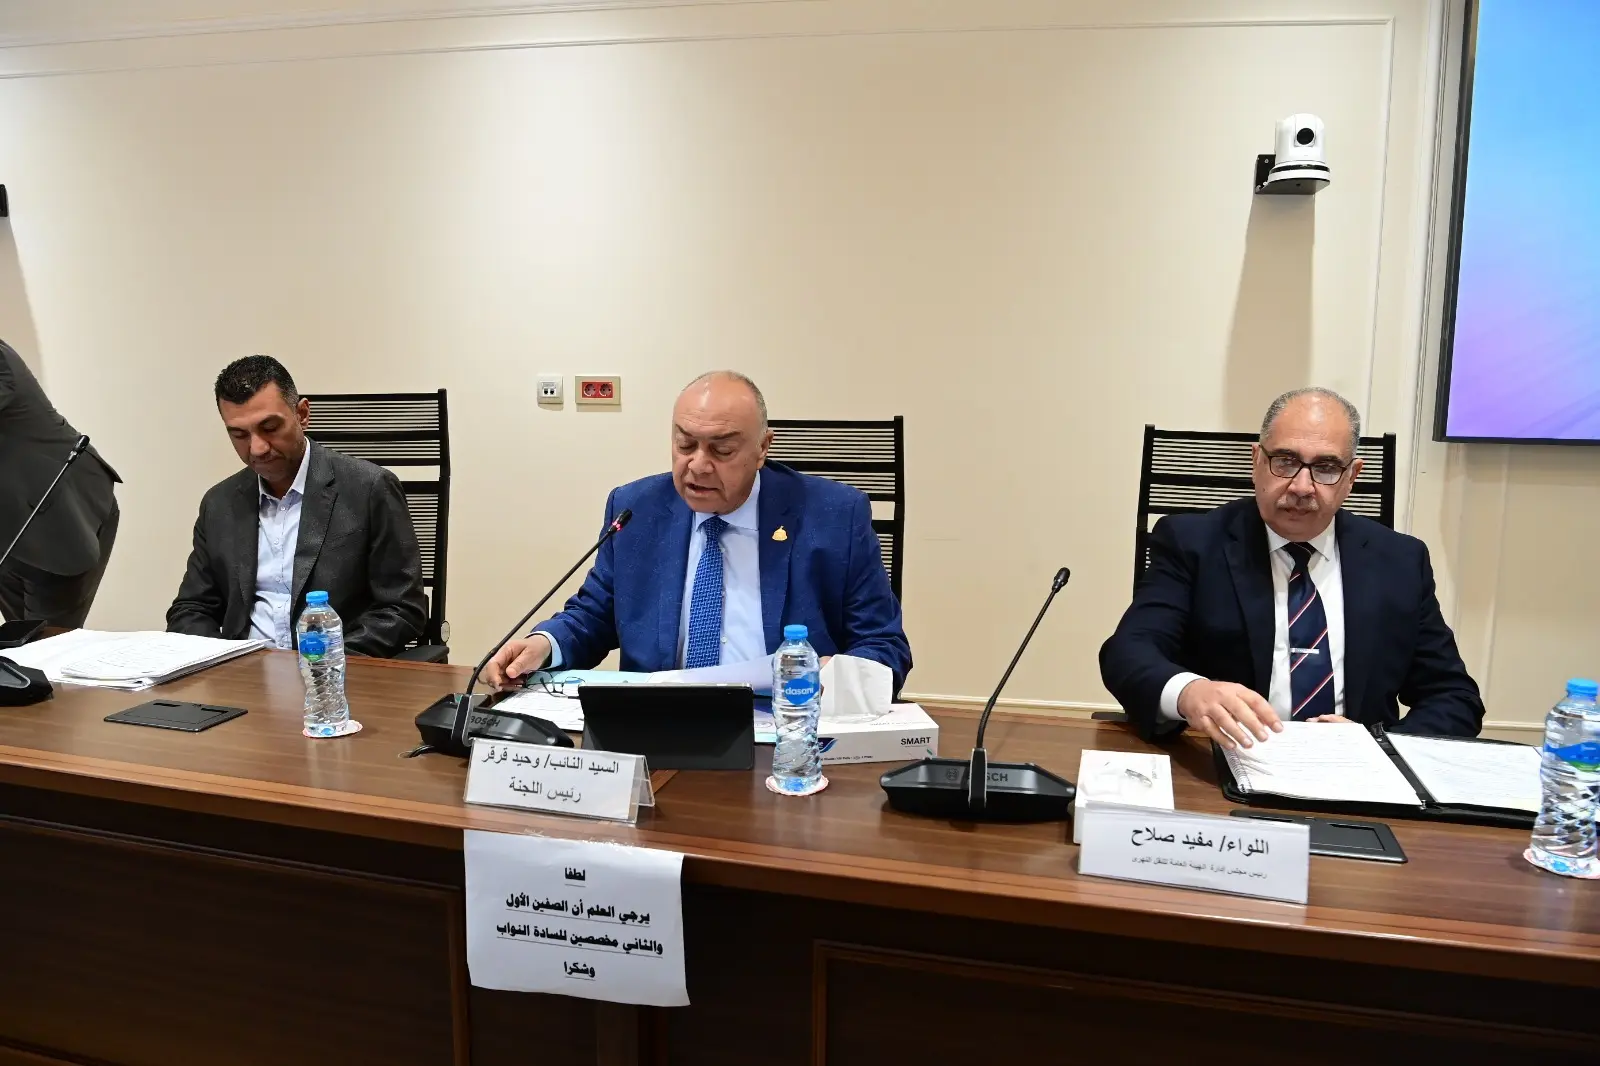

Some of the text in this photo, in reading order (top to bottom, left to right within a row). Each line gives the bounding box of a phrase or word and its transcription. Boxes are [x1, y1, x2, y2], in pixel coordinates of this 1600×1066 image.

[900, 736, 932, 746] SMART
[481, 745, 508, 765] قرقر
[512, 754, 540, 769] وحيد
[588, 760, 619, 776] السيد
[508, 776, 581, 803] رئيس اللجنة
[1131, 827, 1175, 846] صلاح
[1182, 831, 1213, 850] مفيد
[564, 867, 586, 881] لطفا
[505, 891, 530, 909] الأول
[532, 897, 568, 913] الصفين
[571, 898, 584, 916] أن
[587, 904, 615, 919] العلم
[496, 922, 663, 955] والثاني مخصصين للسادة النواب
[563, 961, 596, 978] وشكرا
